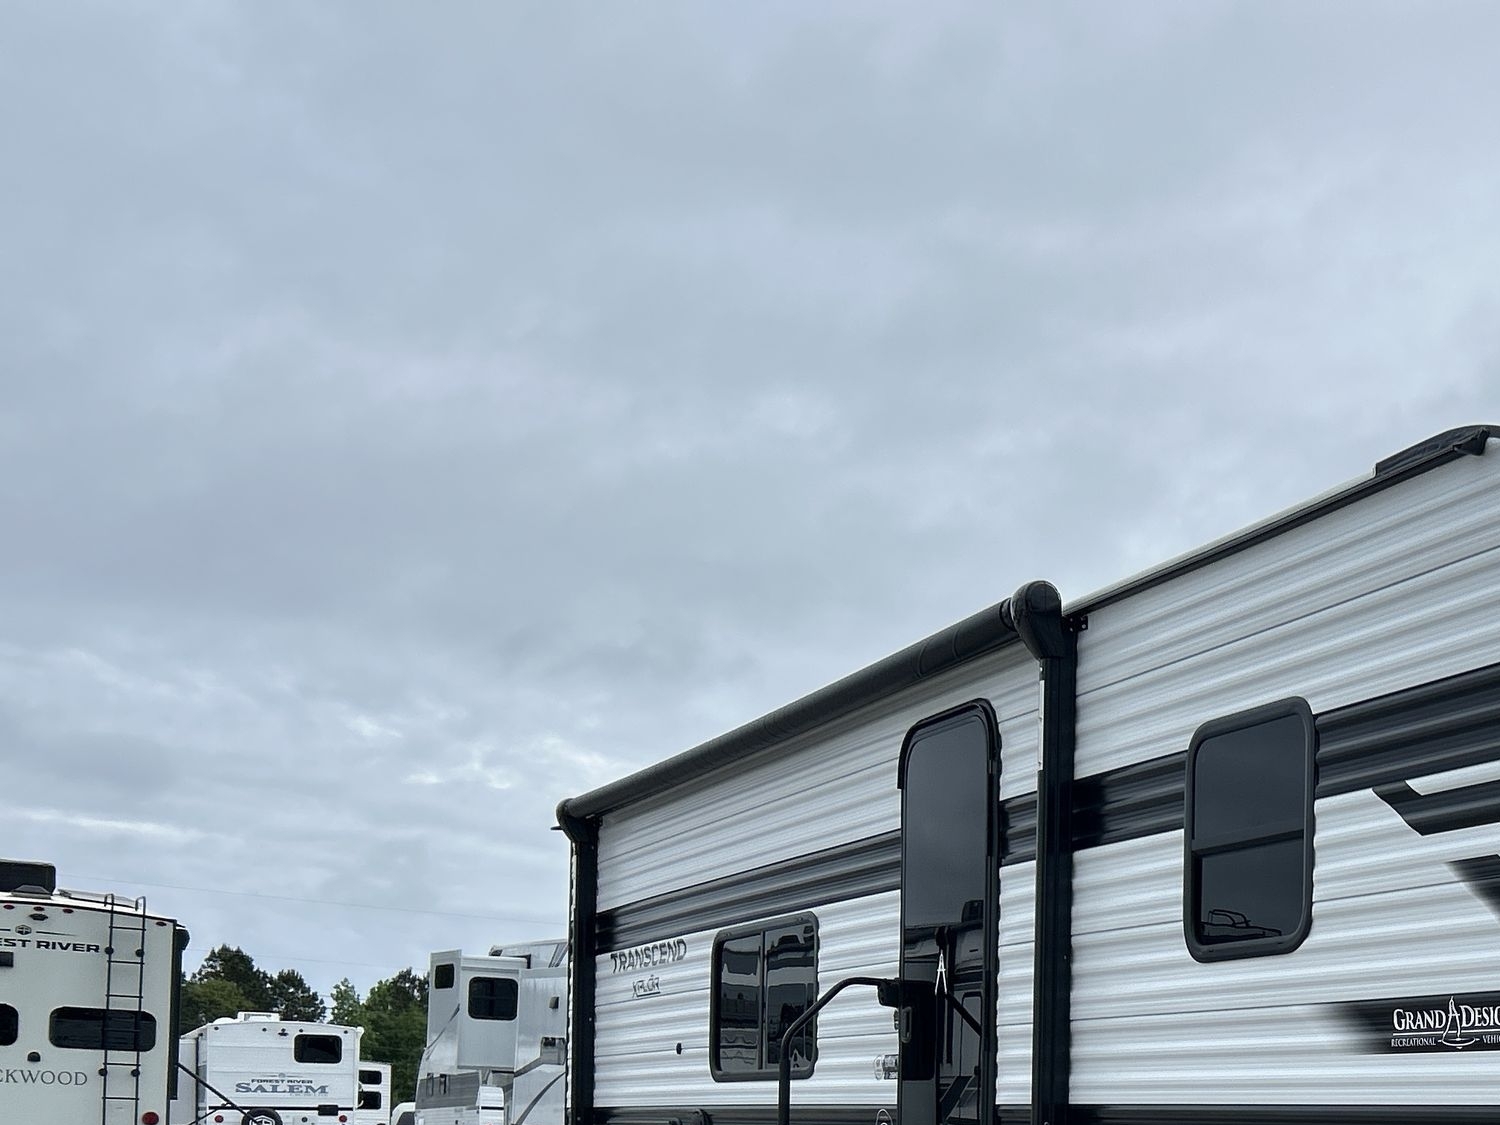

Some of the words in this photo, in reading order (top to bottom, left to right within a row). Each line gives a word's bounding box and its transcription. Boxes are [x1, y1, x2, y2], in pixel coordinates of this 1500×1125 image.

[0, 937, 31, 948] ST
[36, 940, 100, 953] RIVER
[610, 938, 687, 974] TRANSCEND
[1393, 1008, 1447, 1031] GRAND
[1391, 1037, 1437, 1048] RECREATIONAL
[0, 1069, 88, 1086] KWOOD
[235, 1083, 329, 1094] SALEM
